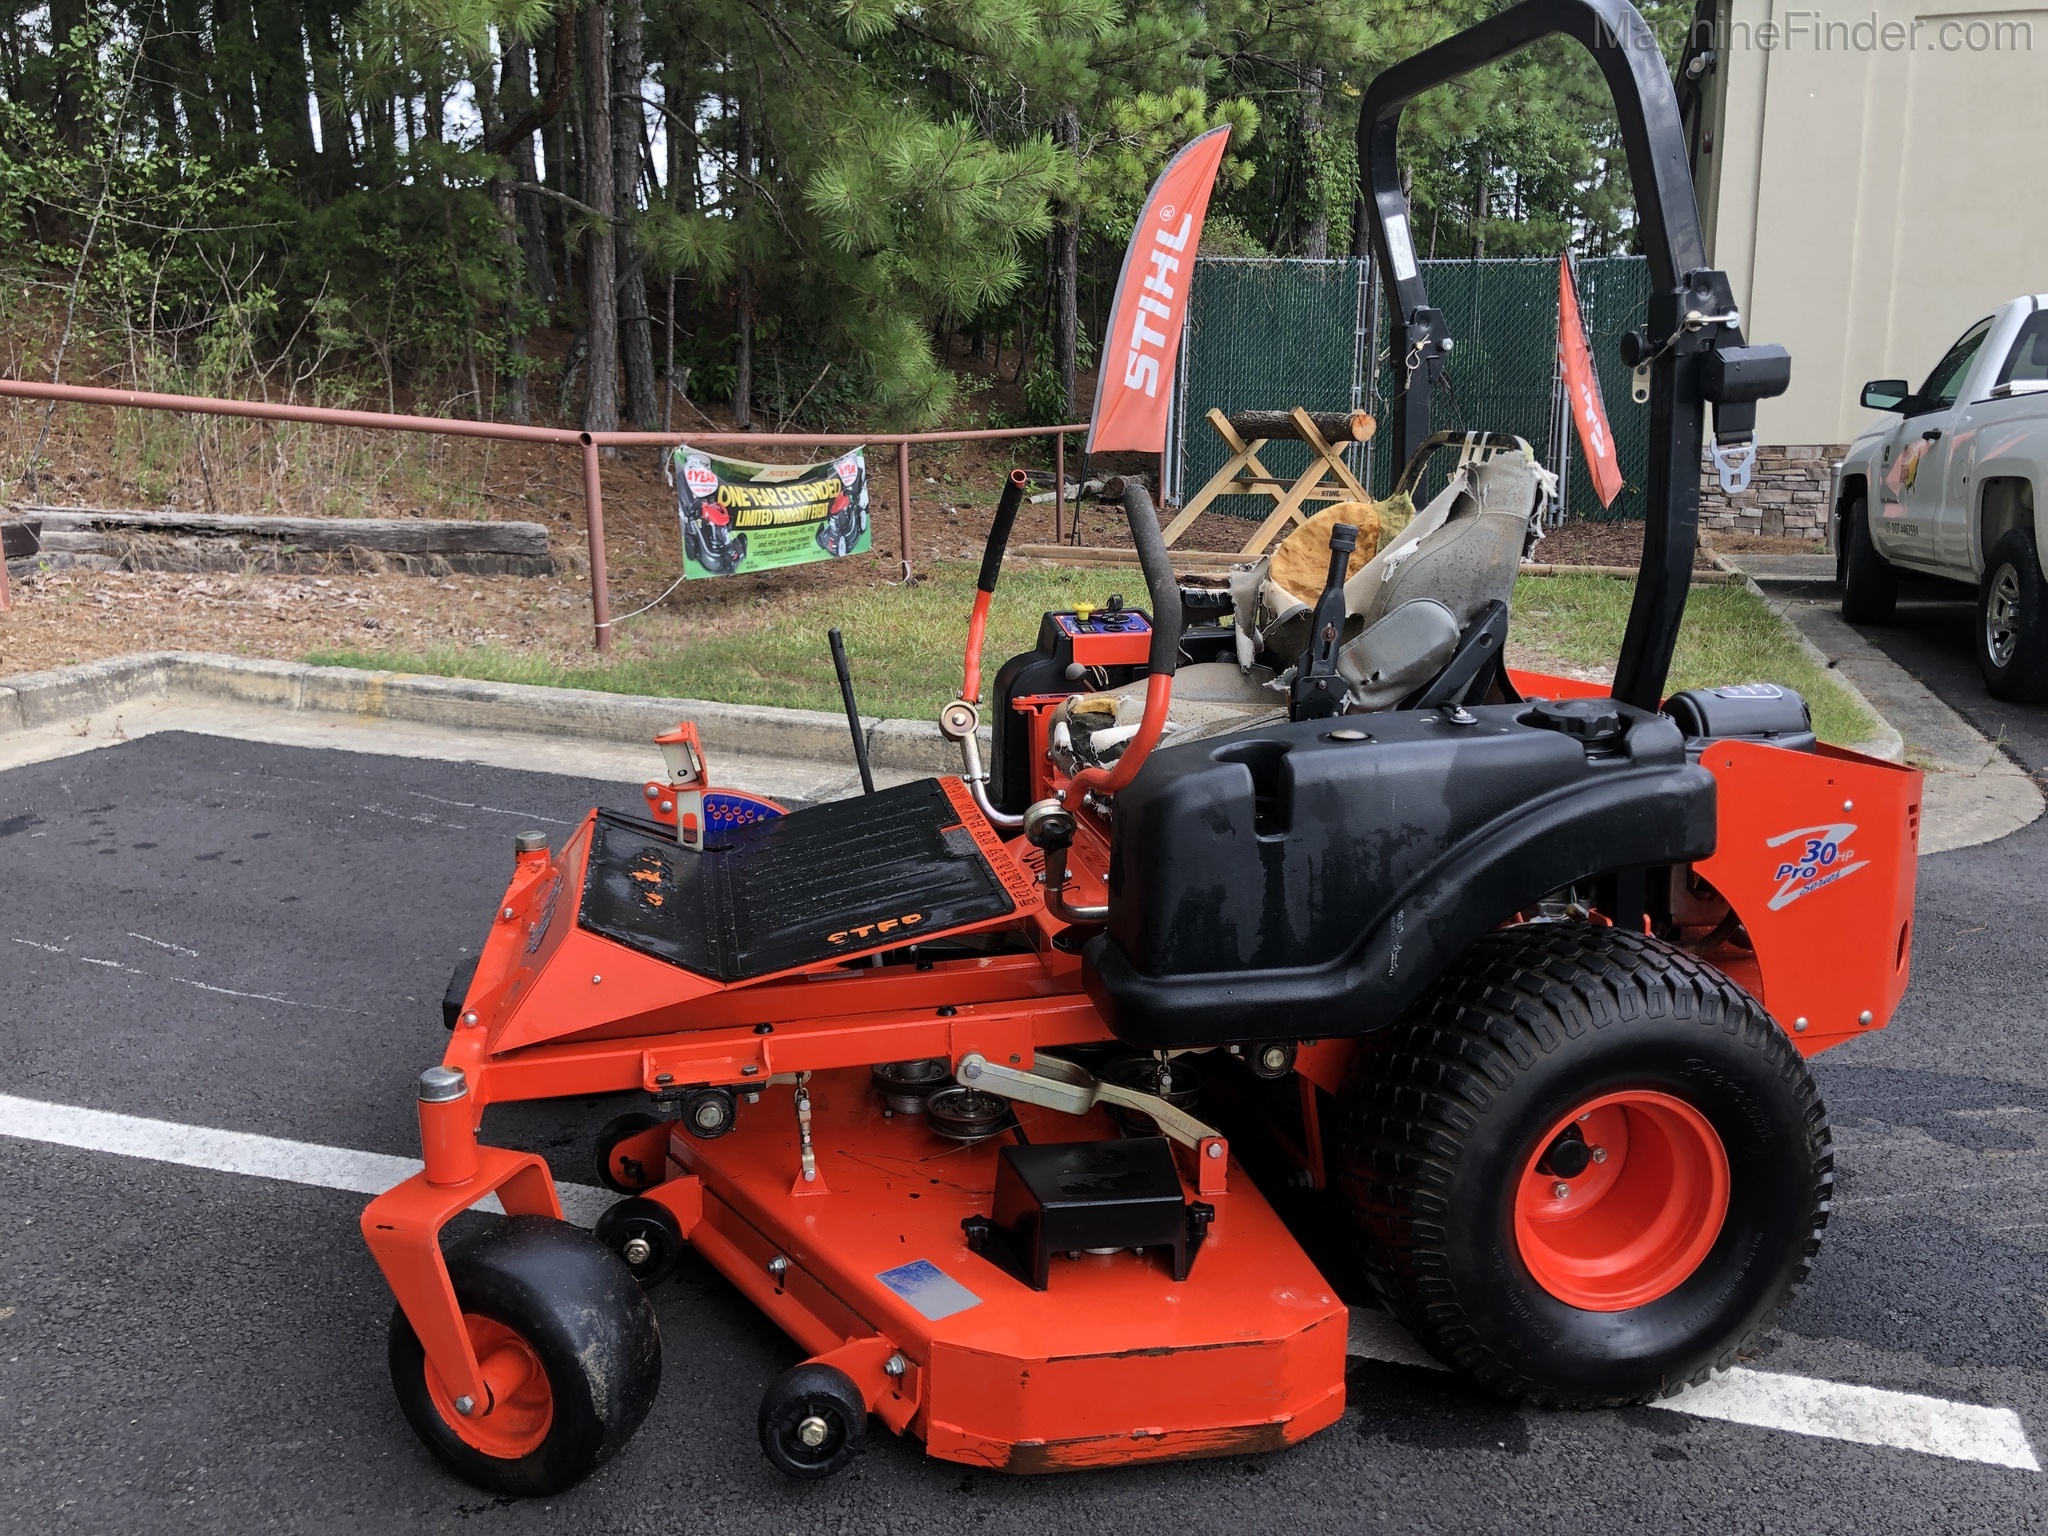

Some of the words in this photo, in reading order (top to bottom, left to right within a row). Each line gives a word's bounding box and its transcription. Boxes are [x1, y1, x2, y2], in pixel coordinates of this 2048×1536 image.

[718, 485, 751, 507] ONE
[746, 487, 782, 507] YEAR
[775, 478, 842, 506] EXTENDED
[735, 510, 773, 527] LIMITED
[772, 505, 812, 524] WARRANTY
[810, 502, 830, 519] EVENT
[943, 780, 968, 800] MOW
[958, 801, 986, 830] WITH
[974, 830, 998, 846] AN
[986, 848, 1038, 908] ATTITUDE
[1799, 839, 1838, 866] 30
[1835, 850, 1855, 862] HP
[1773, 863, 1818, 882] Pro
[1799, 870, 1842, 896] Series
